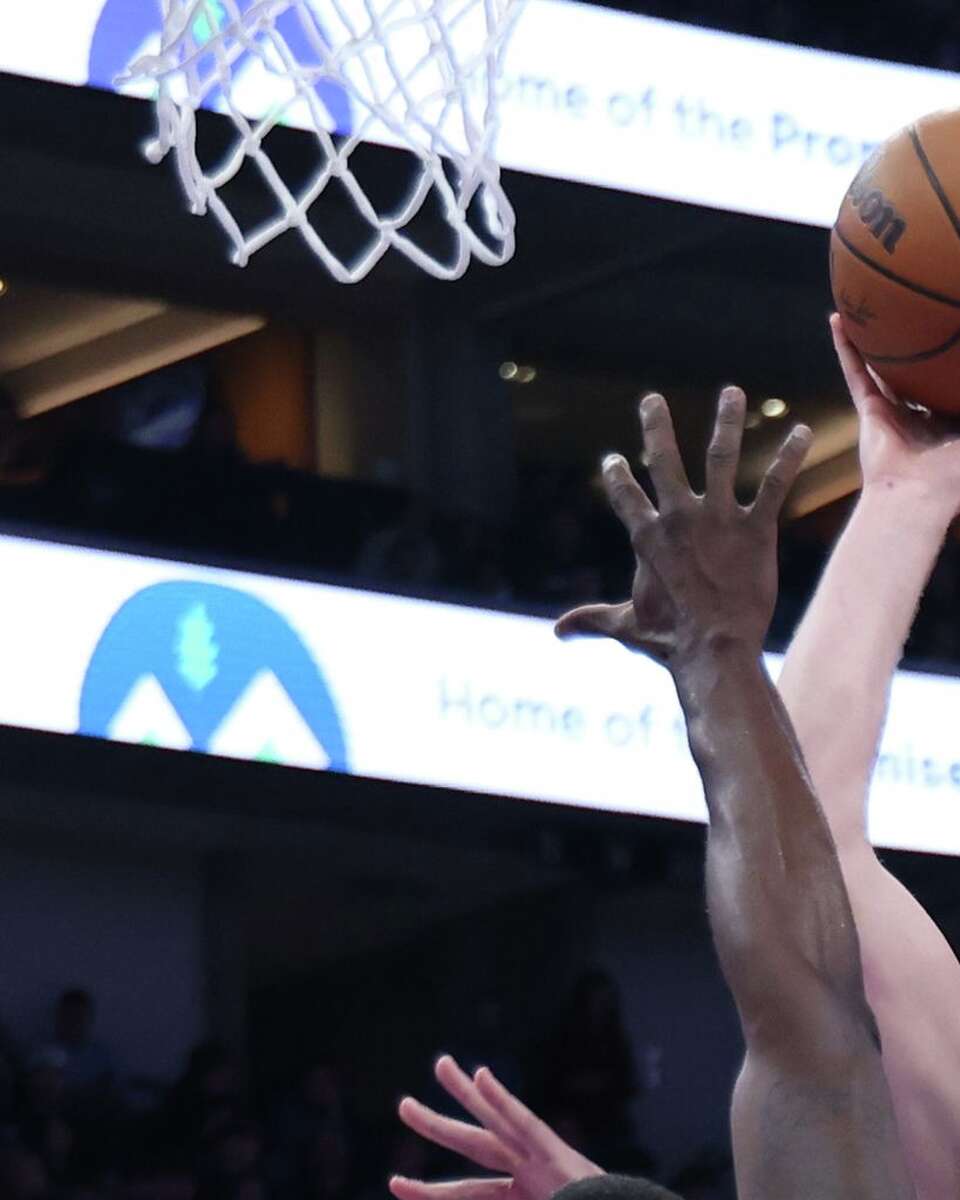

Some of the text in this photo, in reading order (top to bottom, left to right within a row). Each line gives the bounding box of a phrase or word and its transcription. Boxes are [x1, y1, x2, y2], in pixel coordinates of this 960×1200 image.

[490, 72, 590, 121] ome
[604, 88, 656, 129] of
[673, 95, 752, 149] the
[438, 673, 585, 743] Home
[602, 703, 656, 749] of
